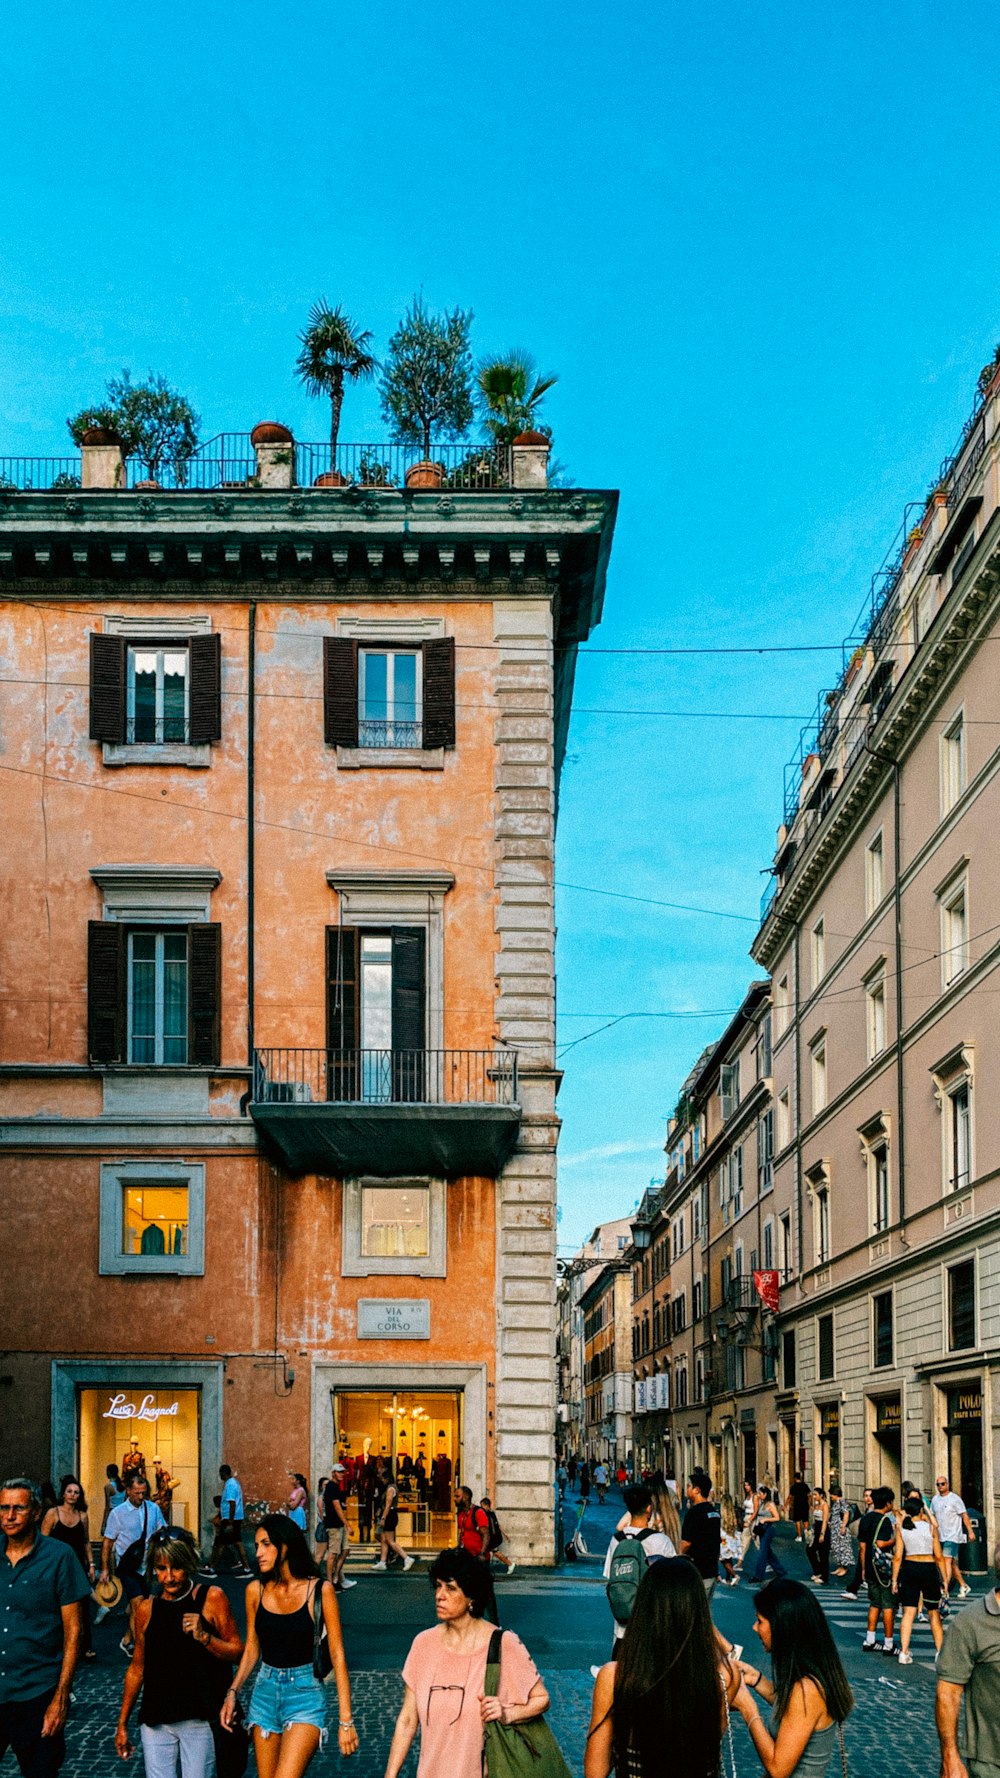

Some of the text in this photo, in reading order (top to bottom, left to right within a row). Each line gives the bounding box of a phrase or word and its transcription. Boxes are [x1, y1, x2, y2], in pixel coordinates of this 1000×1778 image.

[385, 1307, 402, 1315] VIA
[377, 1323, 411, 1331] CORSO
[102, 1394, 179, 1422] Luisa Spagnoli
[959, 1394, 981, 1410] POLO
